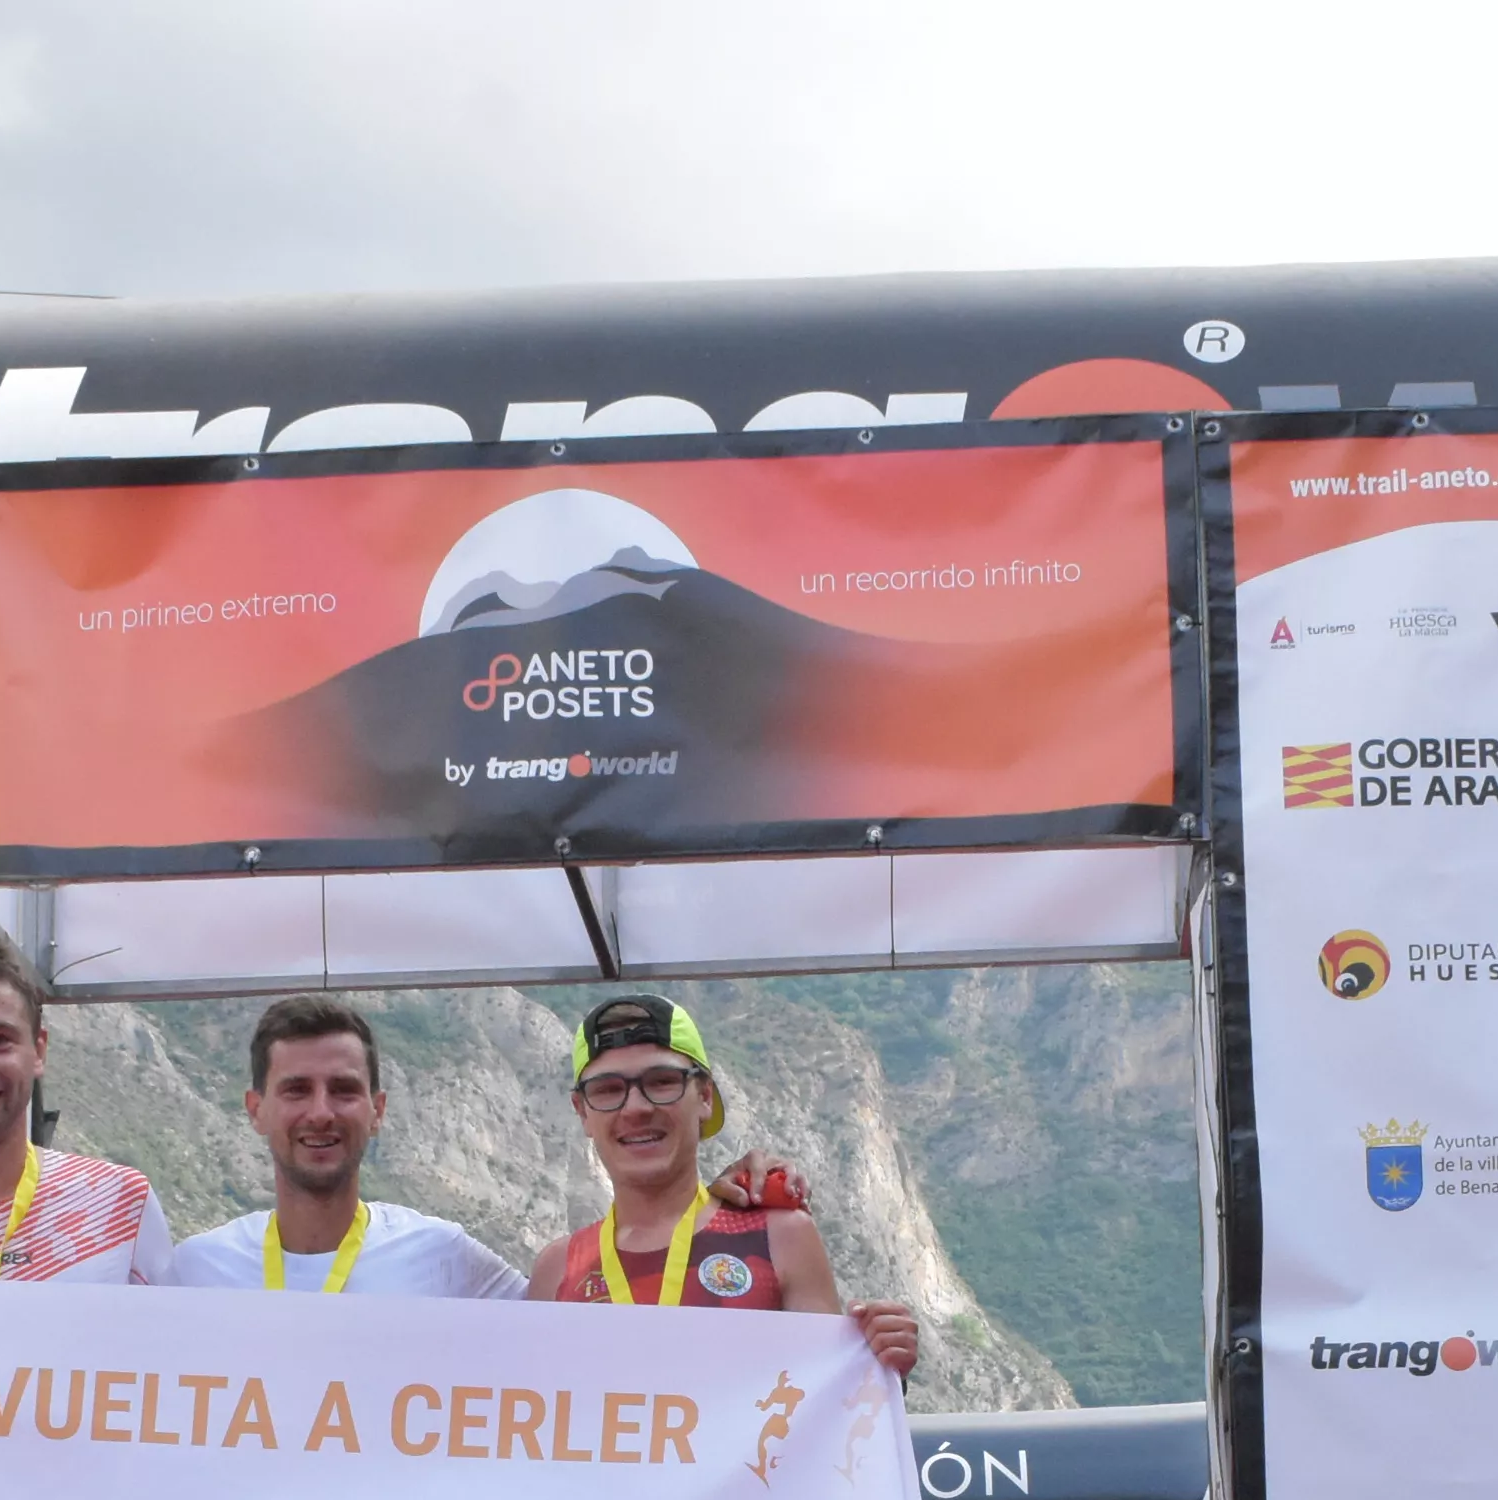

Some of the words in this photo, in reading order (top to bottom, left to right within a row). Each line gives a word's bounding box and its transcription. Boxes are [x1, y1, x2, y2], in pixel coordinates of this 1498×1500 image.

[800, 573, 836, 593] un
[845, 563, 975, 592] recorrido
[983, 559, 1081, 587] infinito
[79, 609, 113, 631] un
[121, 600, 213, 633] pirineo
[220, 589, 337, 622] extremo
[1307, 623, 1356, 635] turismo
[522, 648, 654, 684] ANETO
[502, 685, 655, 721] POSETS
[444, 758, 475, 786] by
[1360, 776, 1413, 807] DE
[1435, 1158, 1455, 1172] de
[1459, 1158, 1474, 1171] la
[1435, 1180, 1456, 1195] de
[304, 1380, 361, 1454] A
[390, 1383, 699, 1465] CERLER
